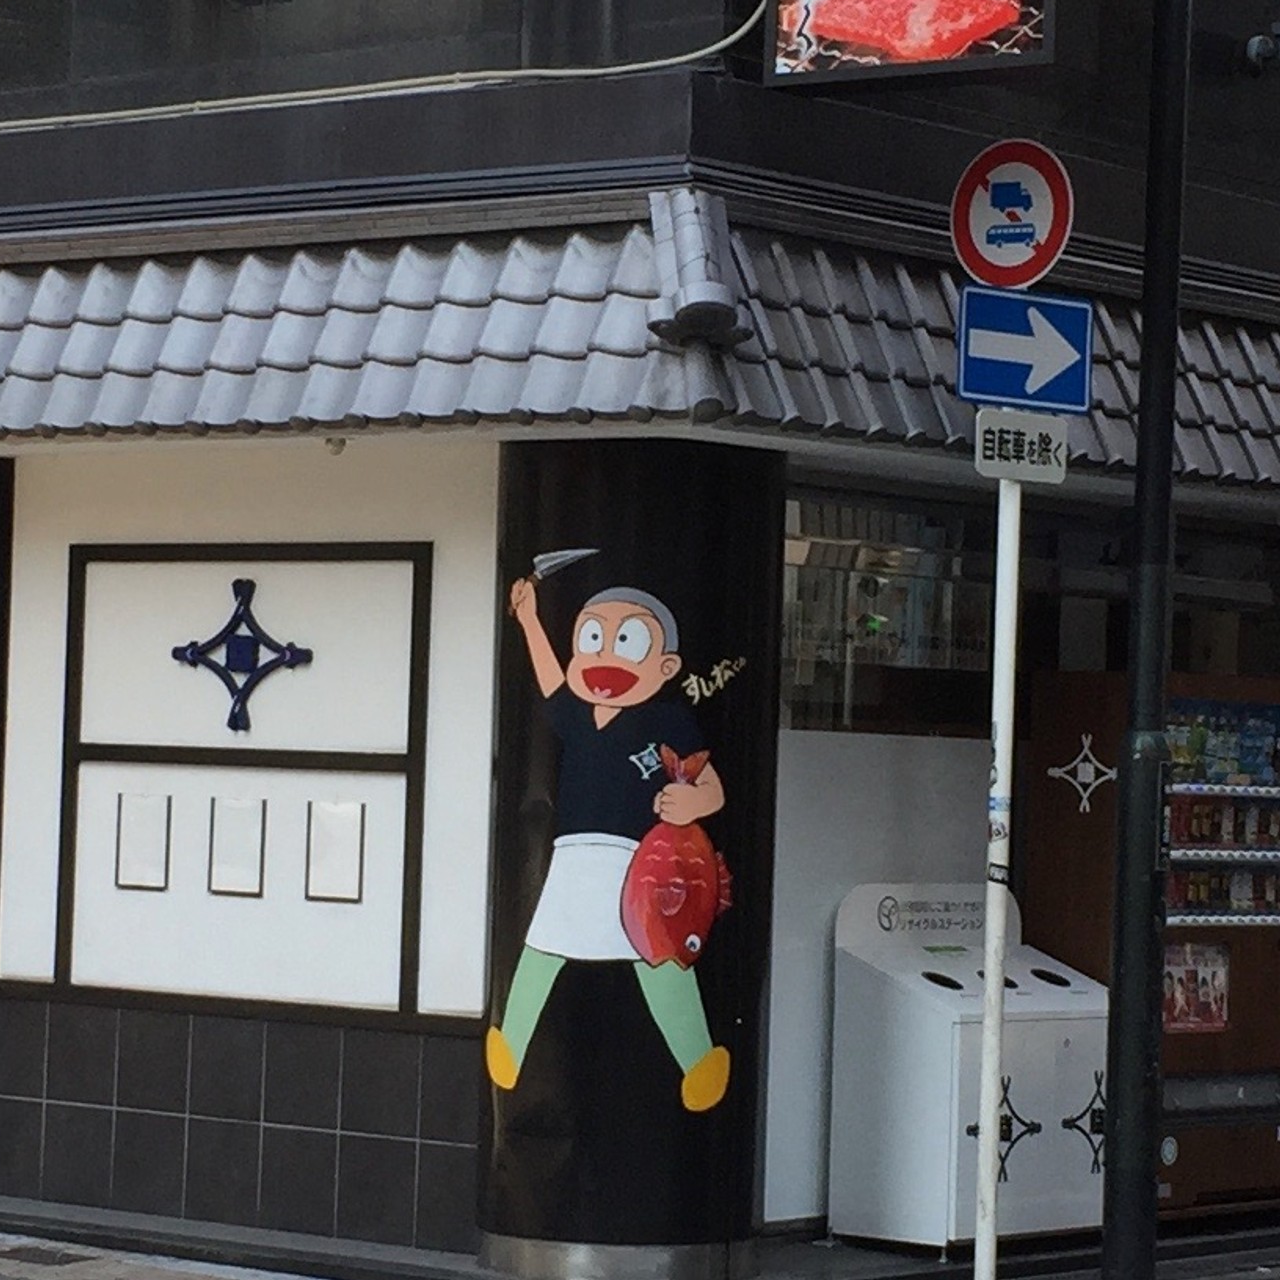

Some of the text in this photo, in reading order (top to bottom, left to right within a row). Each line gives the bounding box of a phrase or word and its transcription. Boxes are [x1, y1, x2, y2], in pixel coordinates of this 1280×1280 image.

[982, 426, 1063, 468] 自転車を除く
[681, 655, 747, 707] すし松くん
